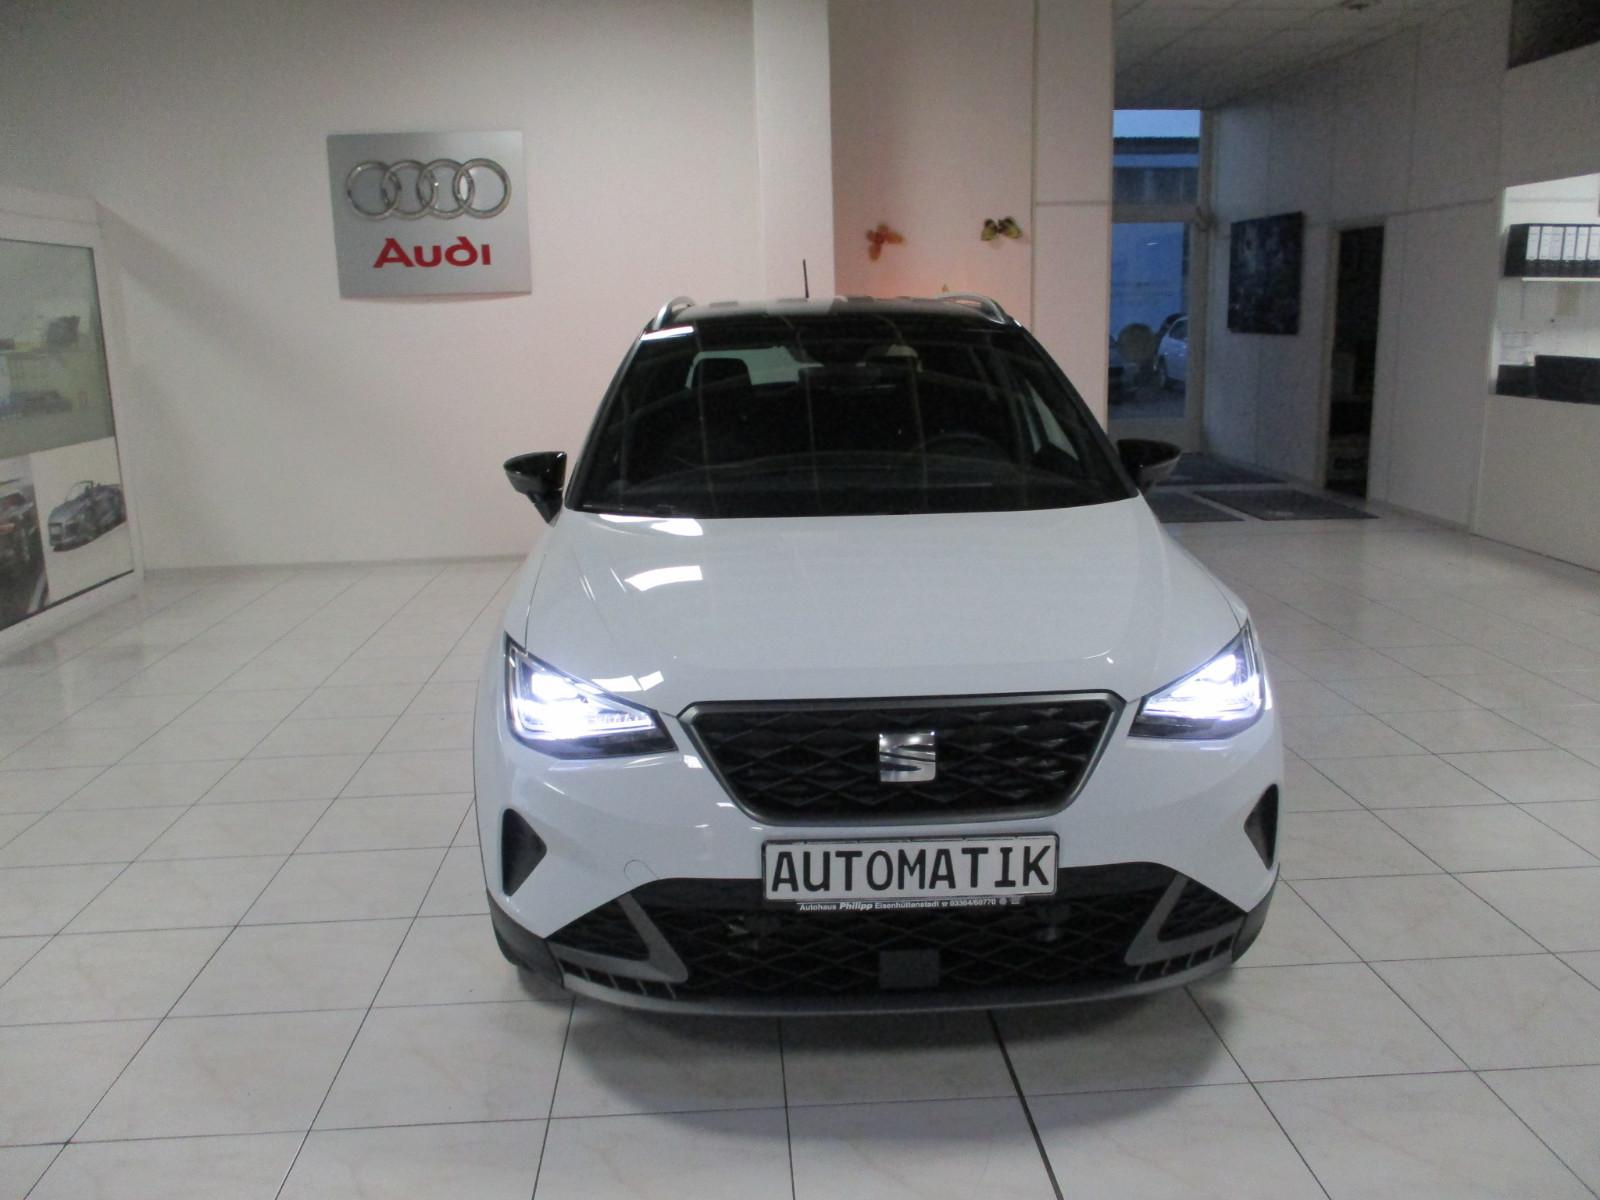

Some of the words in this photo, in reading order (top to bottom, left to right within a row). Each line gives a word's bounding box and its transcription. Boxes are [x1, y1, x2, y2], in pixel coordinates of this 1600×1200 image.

[373, 236, 492, 269] Audi
[771, 845, 1051, 892] AUTOMATIK
[799, 903, 837, 911] Autohaus
[839, 901, 873, 911] Philipp
